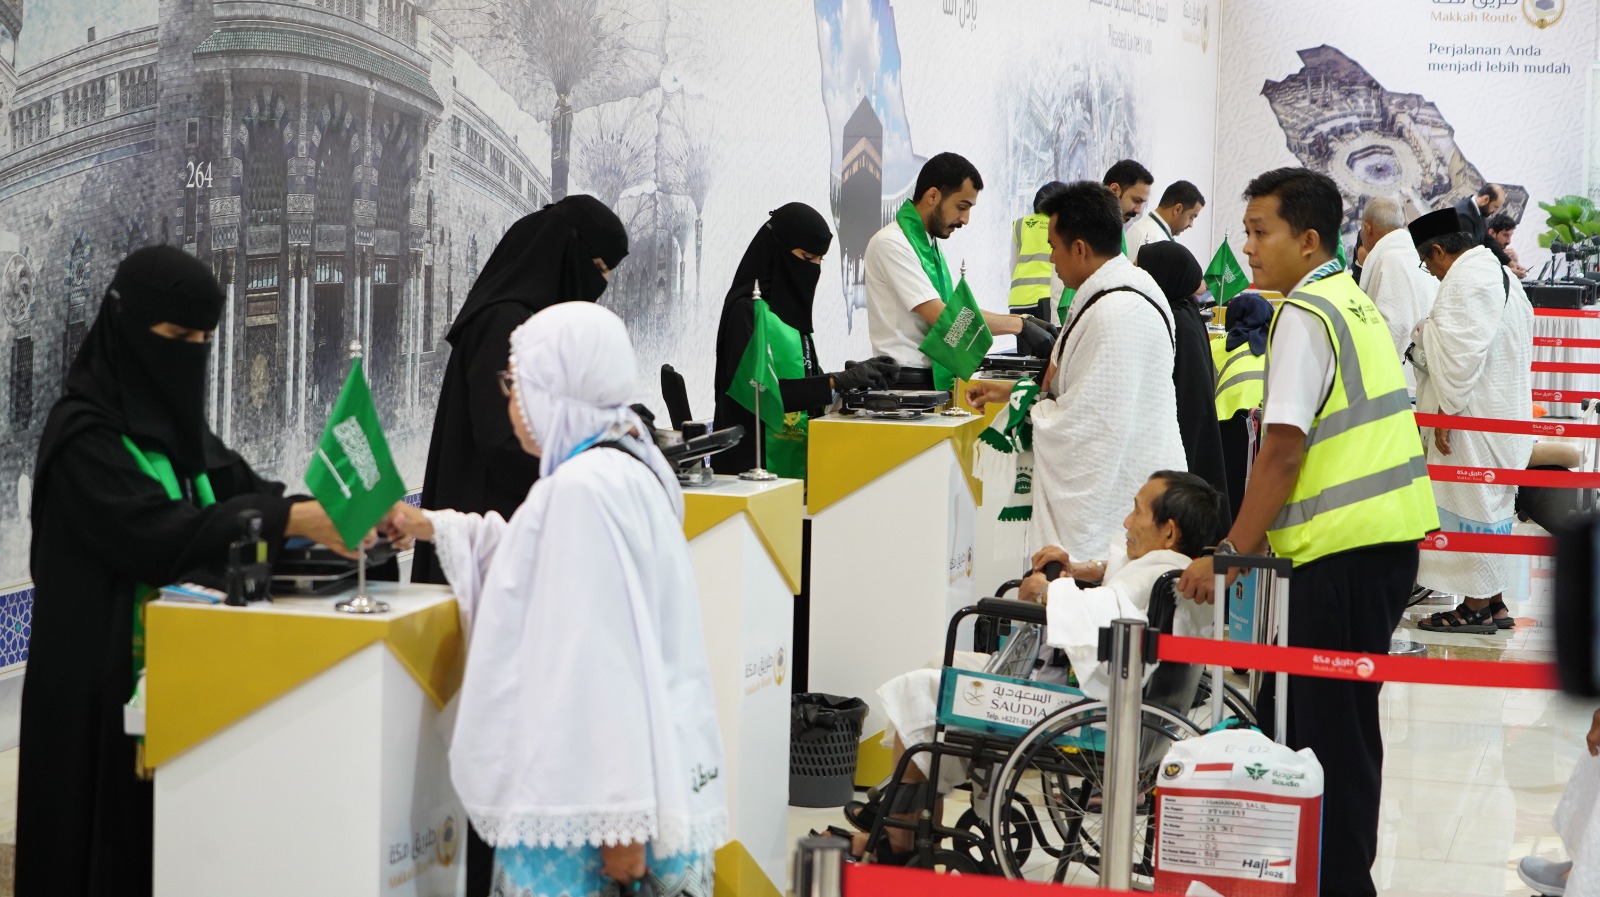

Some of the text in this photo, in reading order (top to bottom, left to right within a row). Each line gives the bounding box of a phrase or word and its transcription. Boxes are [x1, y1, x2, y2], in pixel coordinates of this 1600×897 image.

[1430, 11, 1518, 23] Makkah Route
[1429, 42, 1541, 57] Perjalanan Anda
[1428, 61, 1571, 74] menjadi lebih mudah
[186, 161, 213, 188] 264
[992, 683, 1052, 704] السعودية
[990, 698, 1048, 718] SAUDIA
[1242, 858, 1269, 878] Haji
